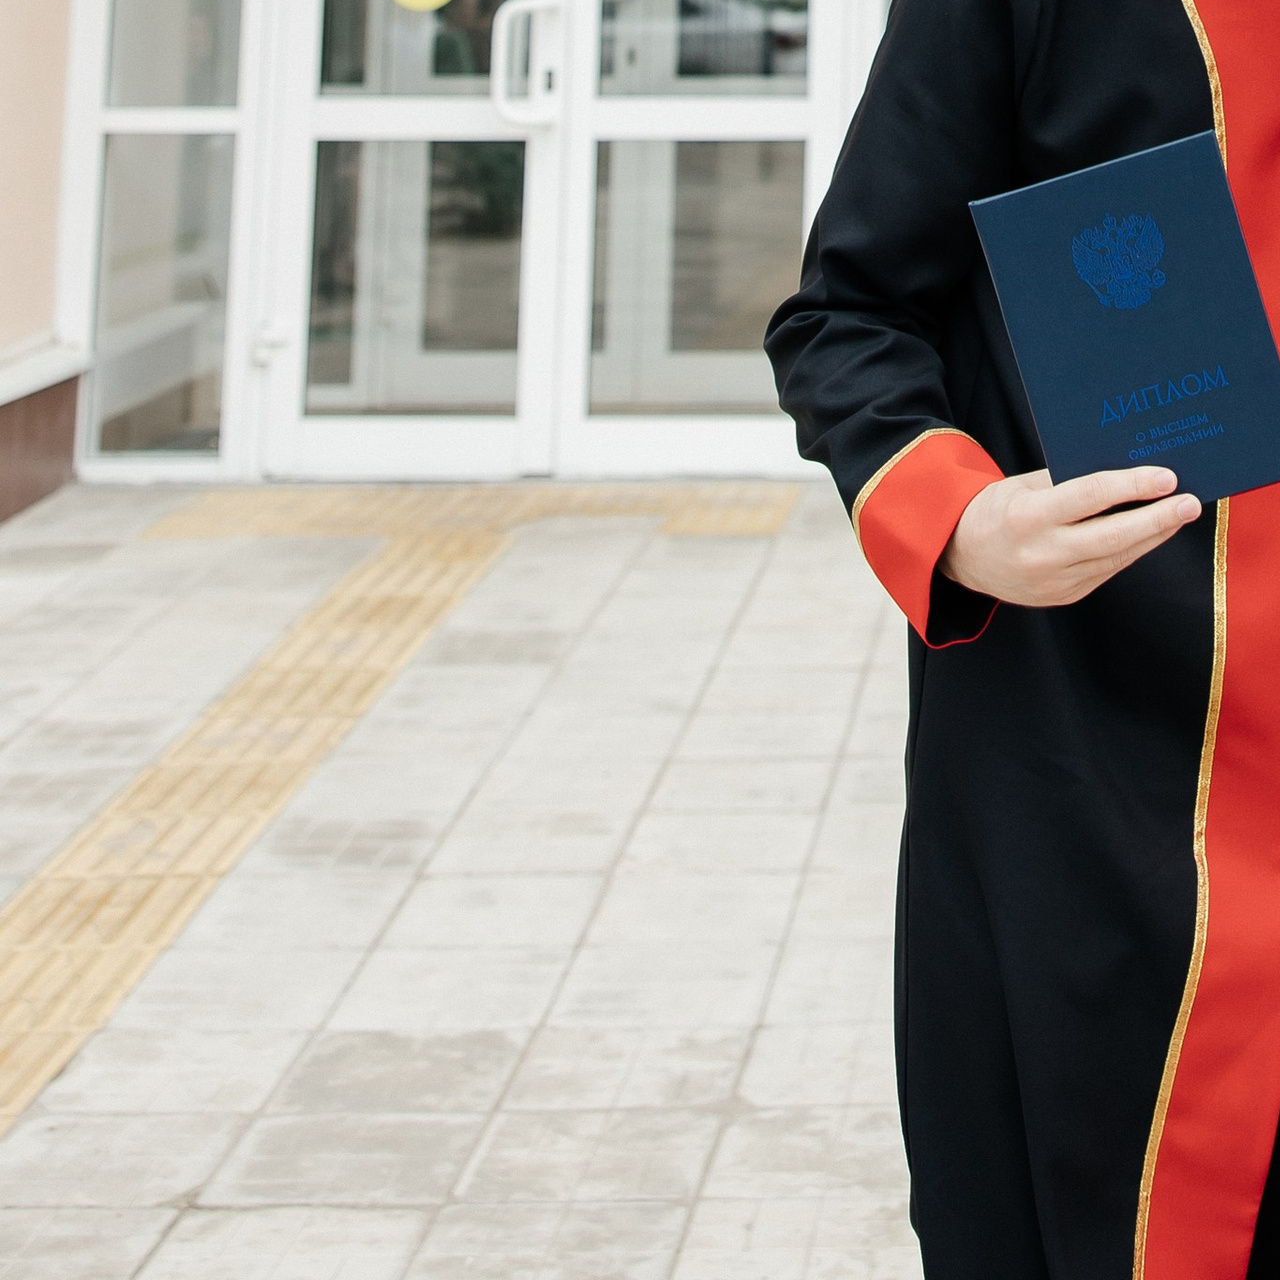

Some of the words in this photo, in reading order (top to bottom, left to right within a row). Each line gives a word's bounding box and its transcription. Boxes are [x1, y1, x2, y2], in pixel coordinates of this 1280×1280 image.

[1101, 364, 1229, 428] ДИПЛОМ
[1128, 423, 1225, 461] ОБРАЗОВАНИИ
[1135, 431, 1147, 443] О
[1149, 412, 1209, 439] ВЫСШЕМ
